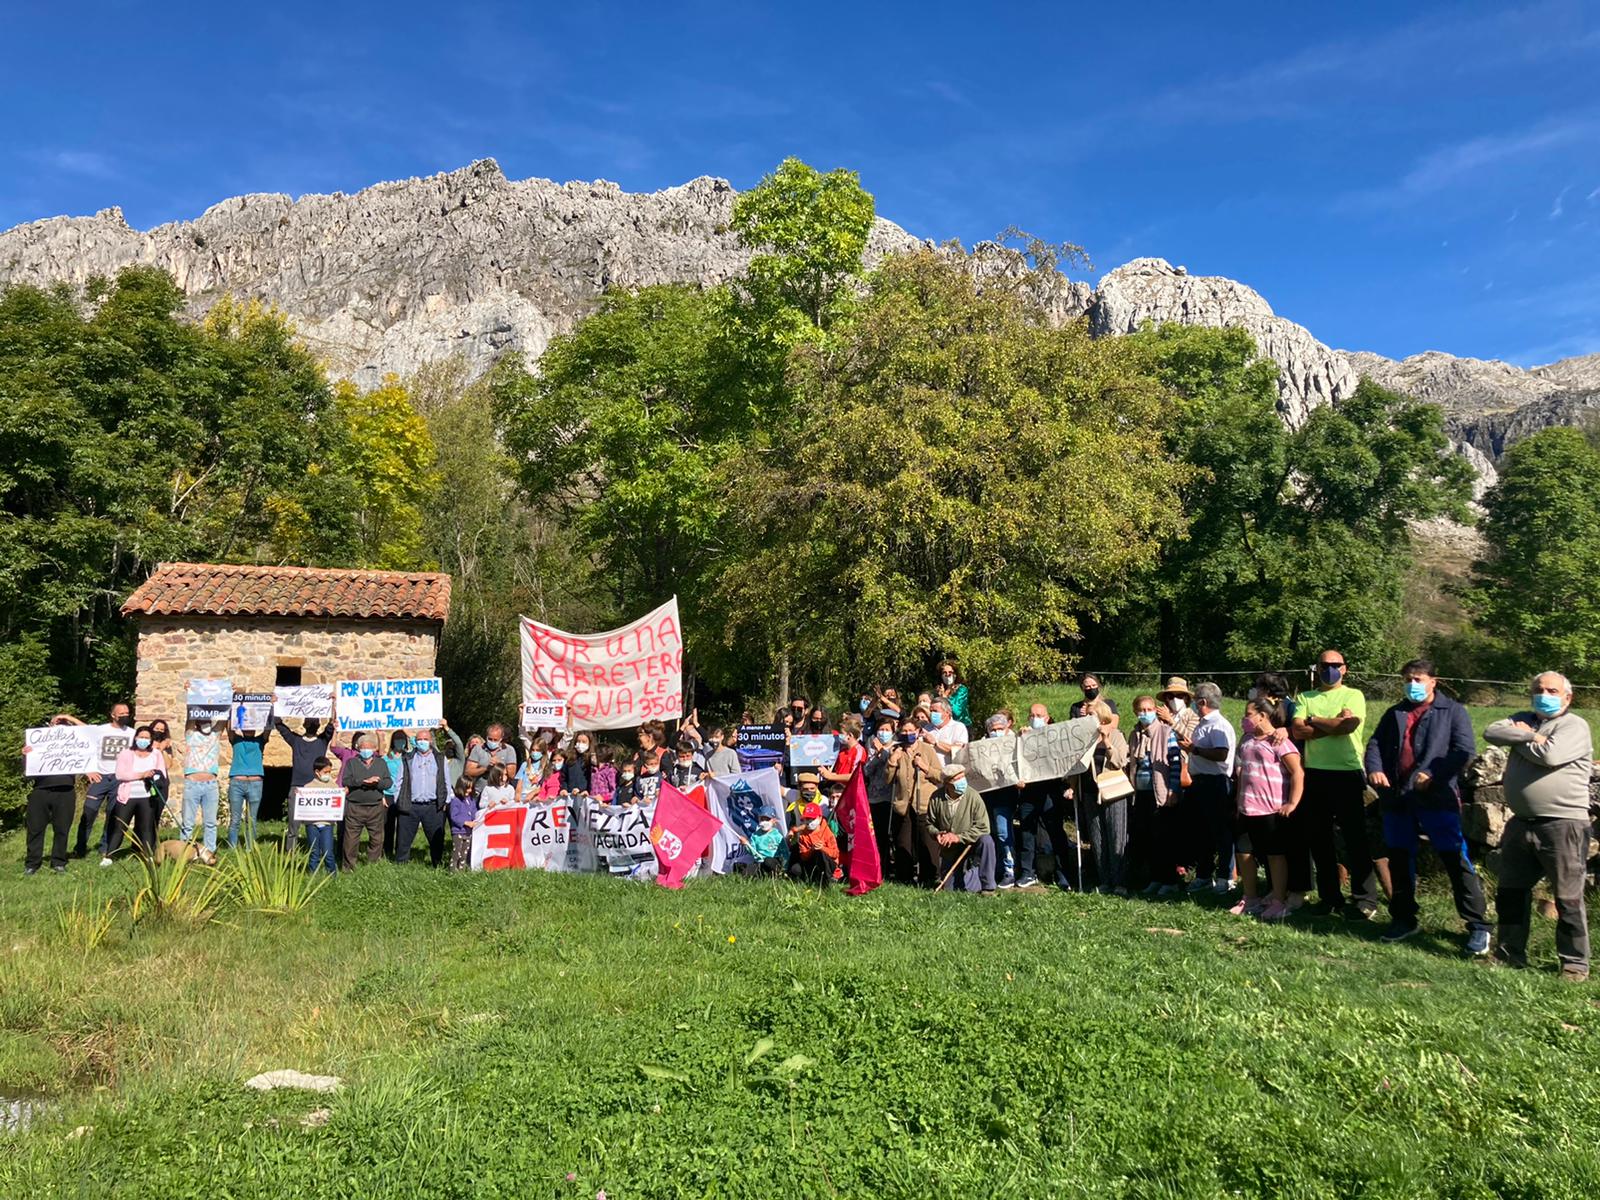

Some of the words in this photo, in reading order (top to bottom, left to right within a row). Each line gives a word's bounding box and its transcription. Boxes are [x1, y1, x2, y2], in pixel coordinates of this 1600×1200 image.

[529, 624, 590, 663] POR
[605, 616, 680, 657] UNA
[341, 682, 358, 697] POR
[361, 681, 383, 697] UNA
[386, 680, 440, 695] CARRETERA
[643, 679, 669, 695] LE
[363, 697, 416, 713] DIGNA
[536, 687, 633, 719] GNA
[737, 732, 749, 741] 30
[750, 732, 785, 741] minutos
[531, 832, 551, 846] de
[554, 829, 566, 843] la
